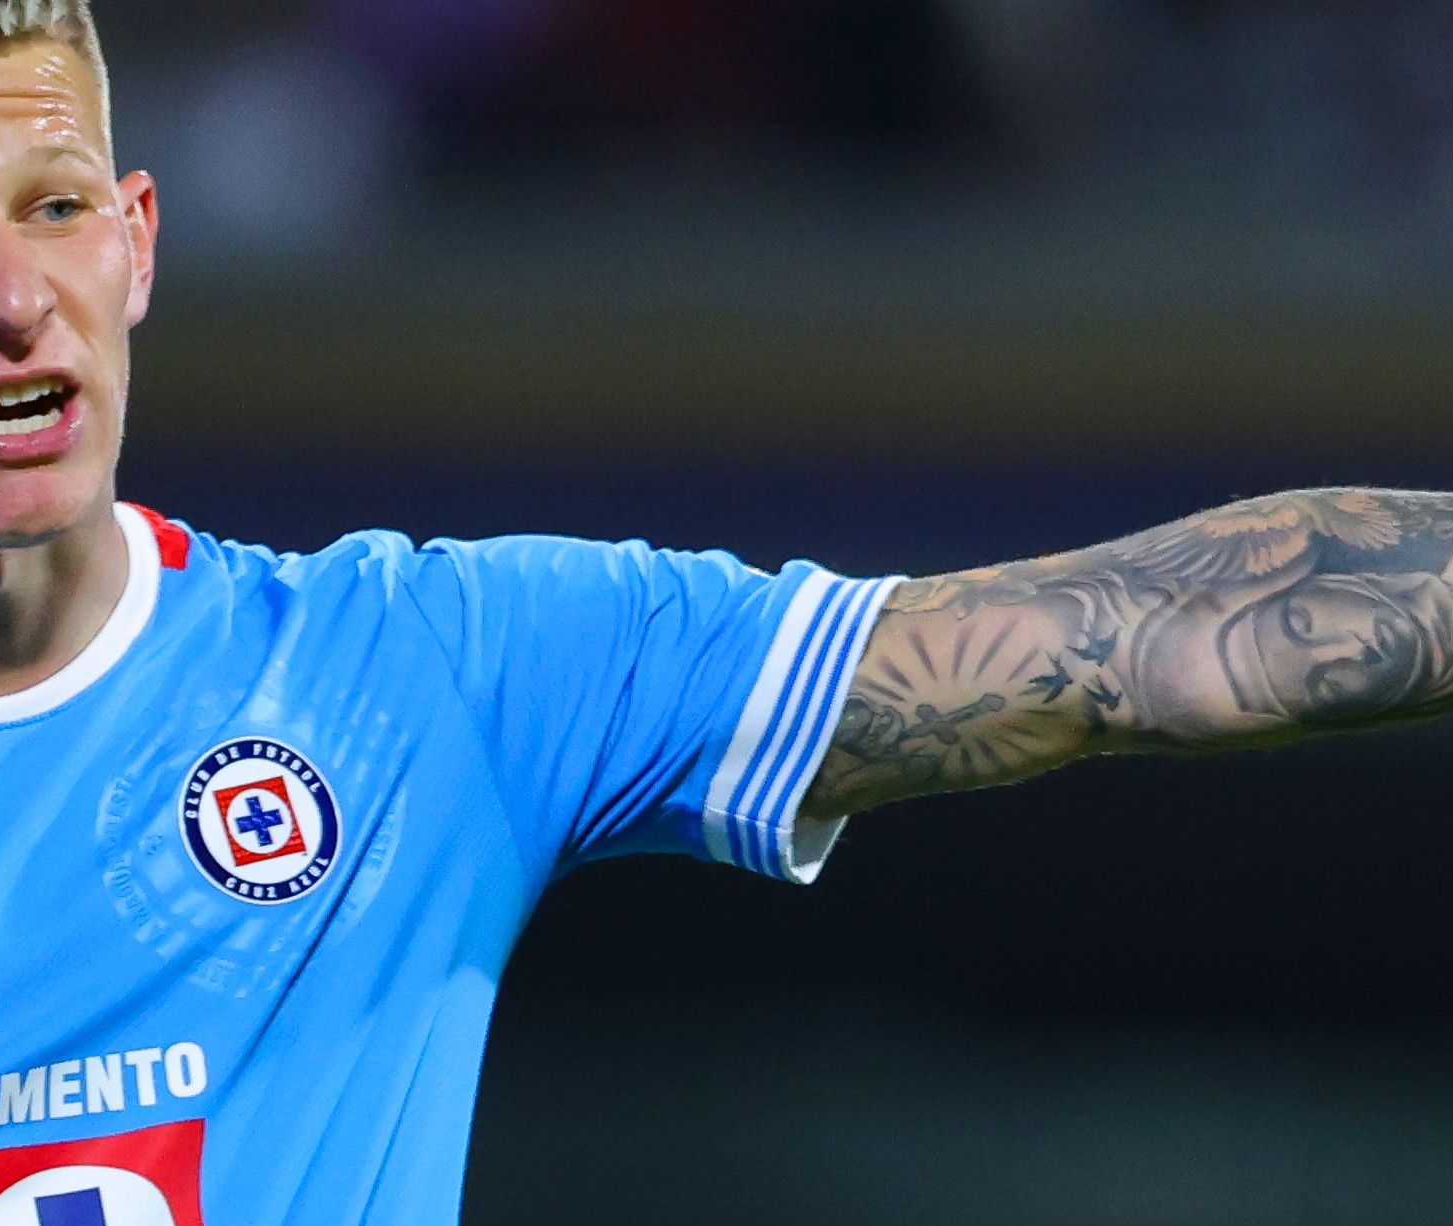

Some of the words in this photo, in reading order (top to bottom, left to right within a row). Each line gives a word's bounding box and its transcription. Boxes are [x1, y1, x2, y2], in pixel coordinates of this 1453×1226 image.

[185, 769, 212, 819] CLUB
[214, 745, 241, 766] DE
[224, 877, 279, 899] CRUZ
[288, 856, 330, 894] AZUL
